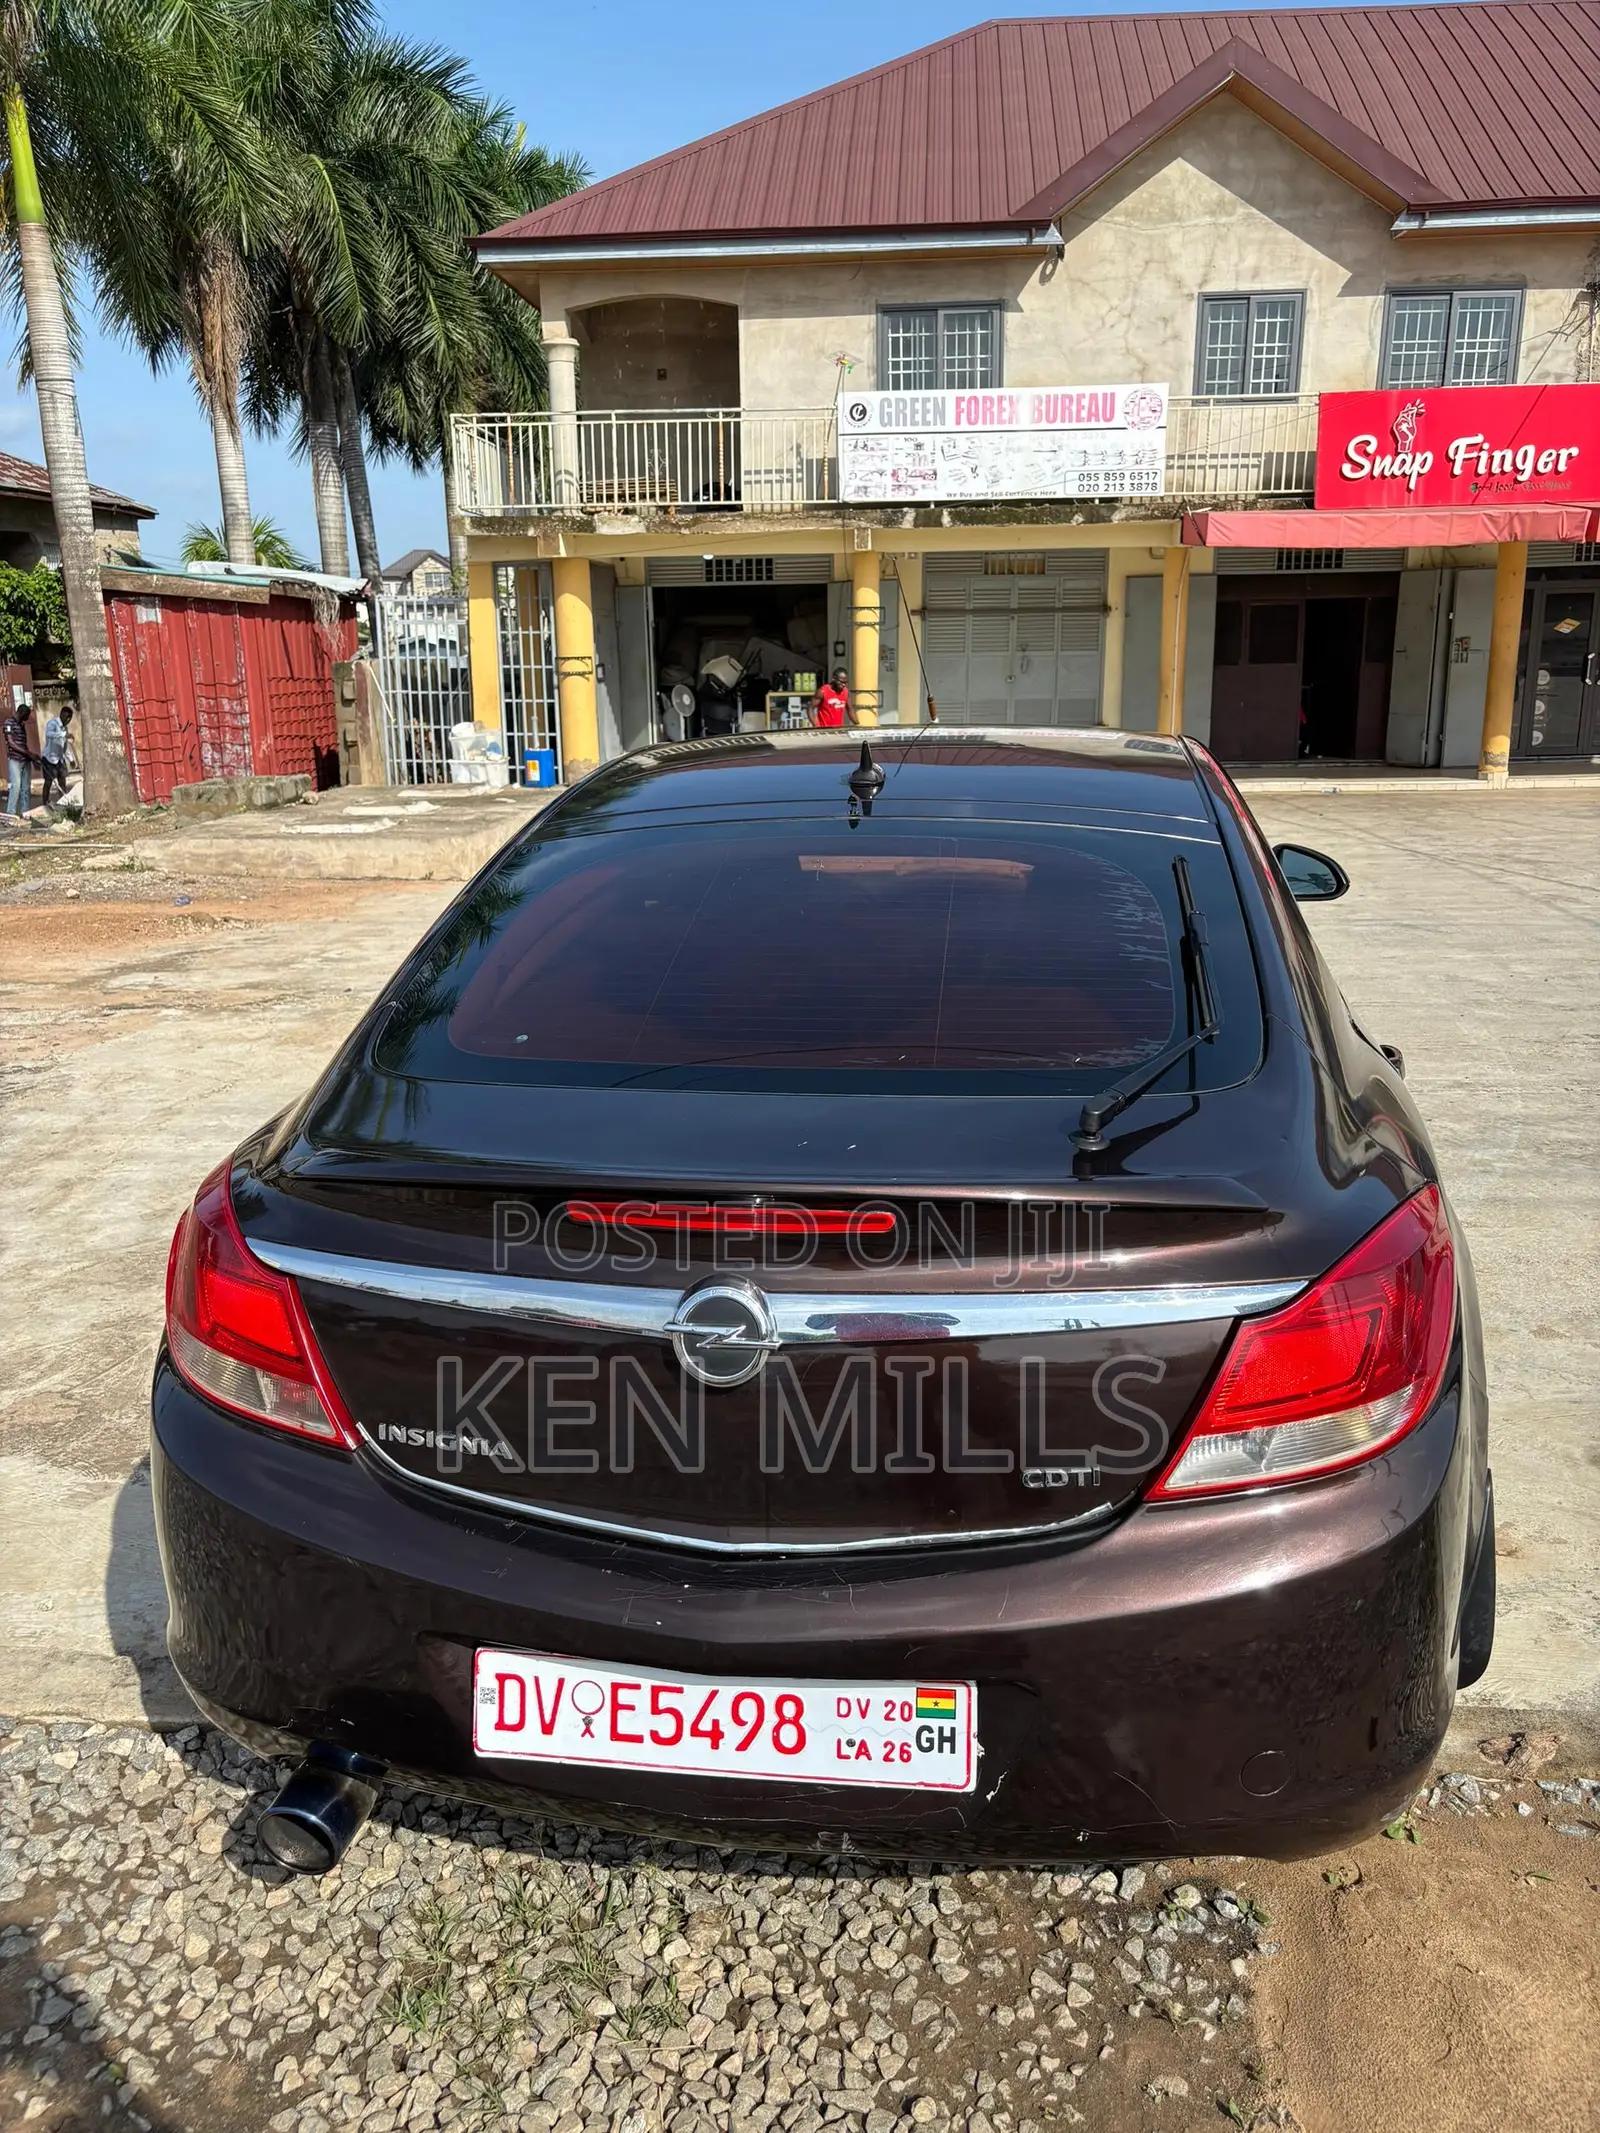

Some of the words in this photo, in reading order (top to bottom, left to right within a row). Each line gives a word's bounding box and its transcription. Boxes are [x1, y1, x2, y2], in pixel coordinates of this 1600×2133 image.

[878, 396, 947, 428] GREEN
[954, 394, 1021, 426] FOREX
[1031, 392, 1116, 425] BUREAU
[1341, 434, 1434, 490] Snap
[1447, 433, 1579, 481] Finger
[1077, 483, 1100, 493] 020
[1103, 483, 1125, 492] 213
[1129, 482, 1158, 492] 3878
[1078, 472, 1100, 482] 055
[1103, 472, 1126, 481] 859
[1129, 471, 1158, 481] 6517
[378, 1422, 515, 1461] INSIGNIA
[1022, 1465, 1101, 1489] CDTI
[494, 1672, 566, 1736] DV
[609, 1680, 808, 1756] E5498
[836, 1697, 871, 1720] DV
[883, 1699, 913, 1722] 20
[836, 1737, 872, 1761] LA
[882, 1740, 913, 1763] 26
[915, 1725, 957, 1754] GH
